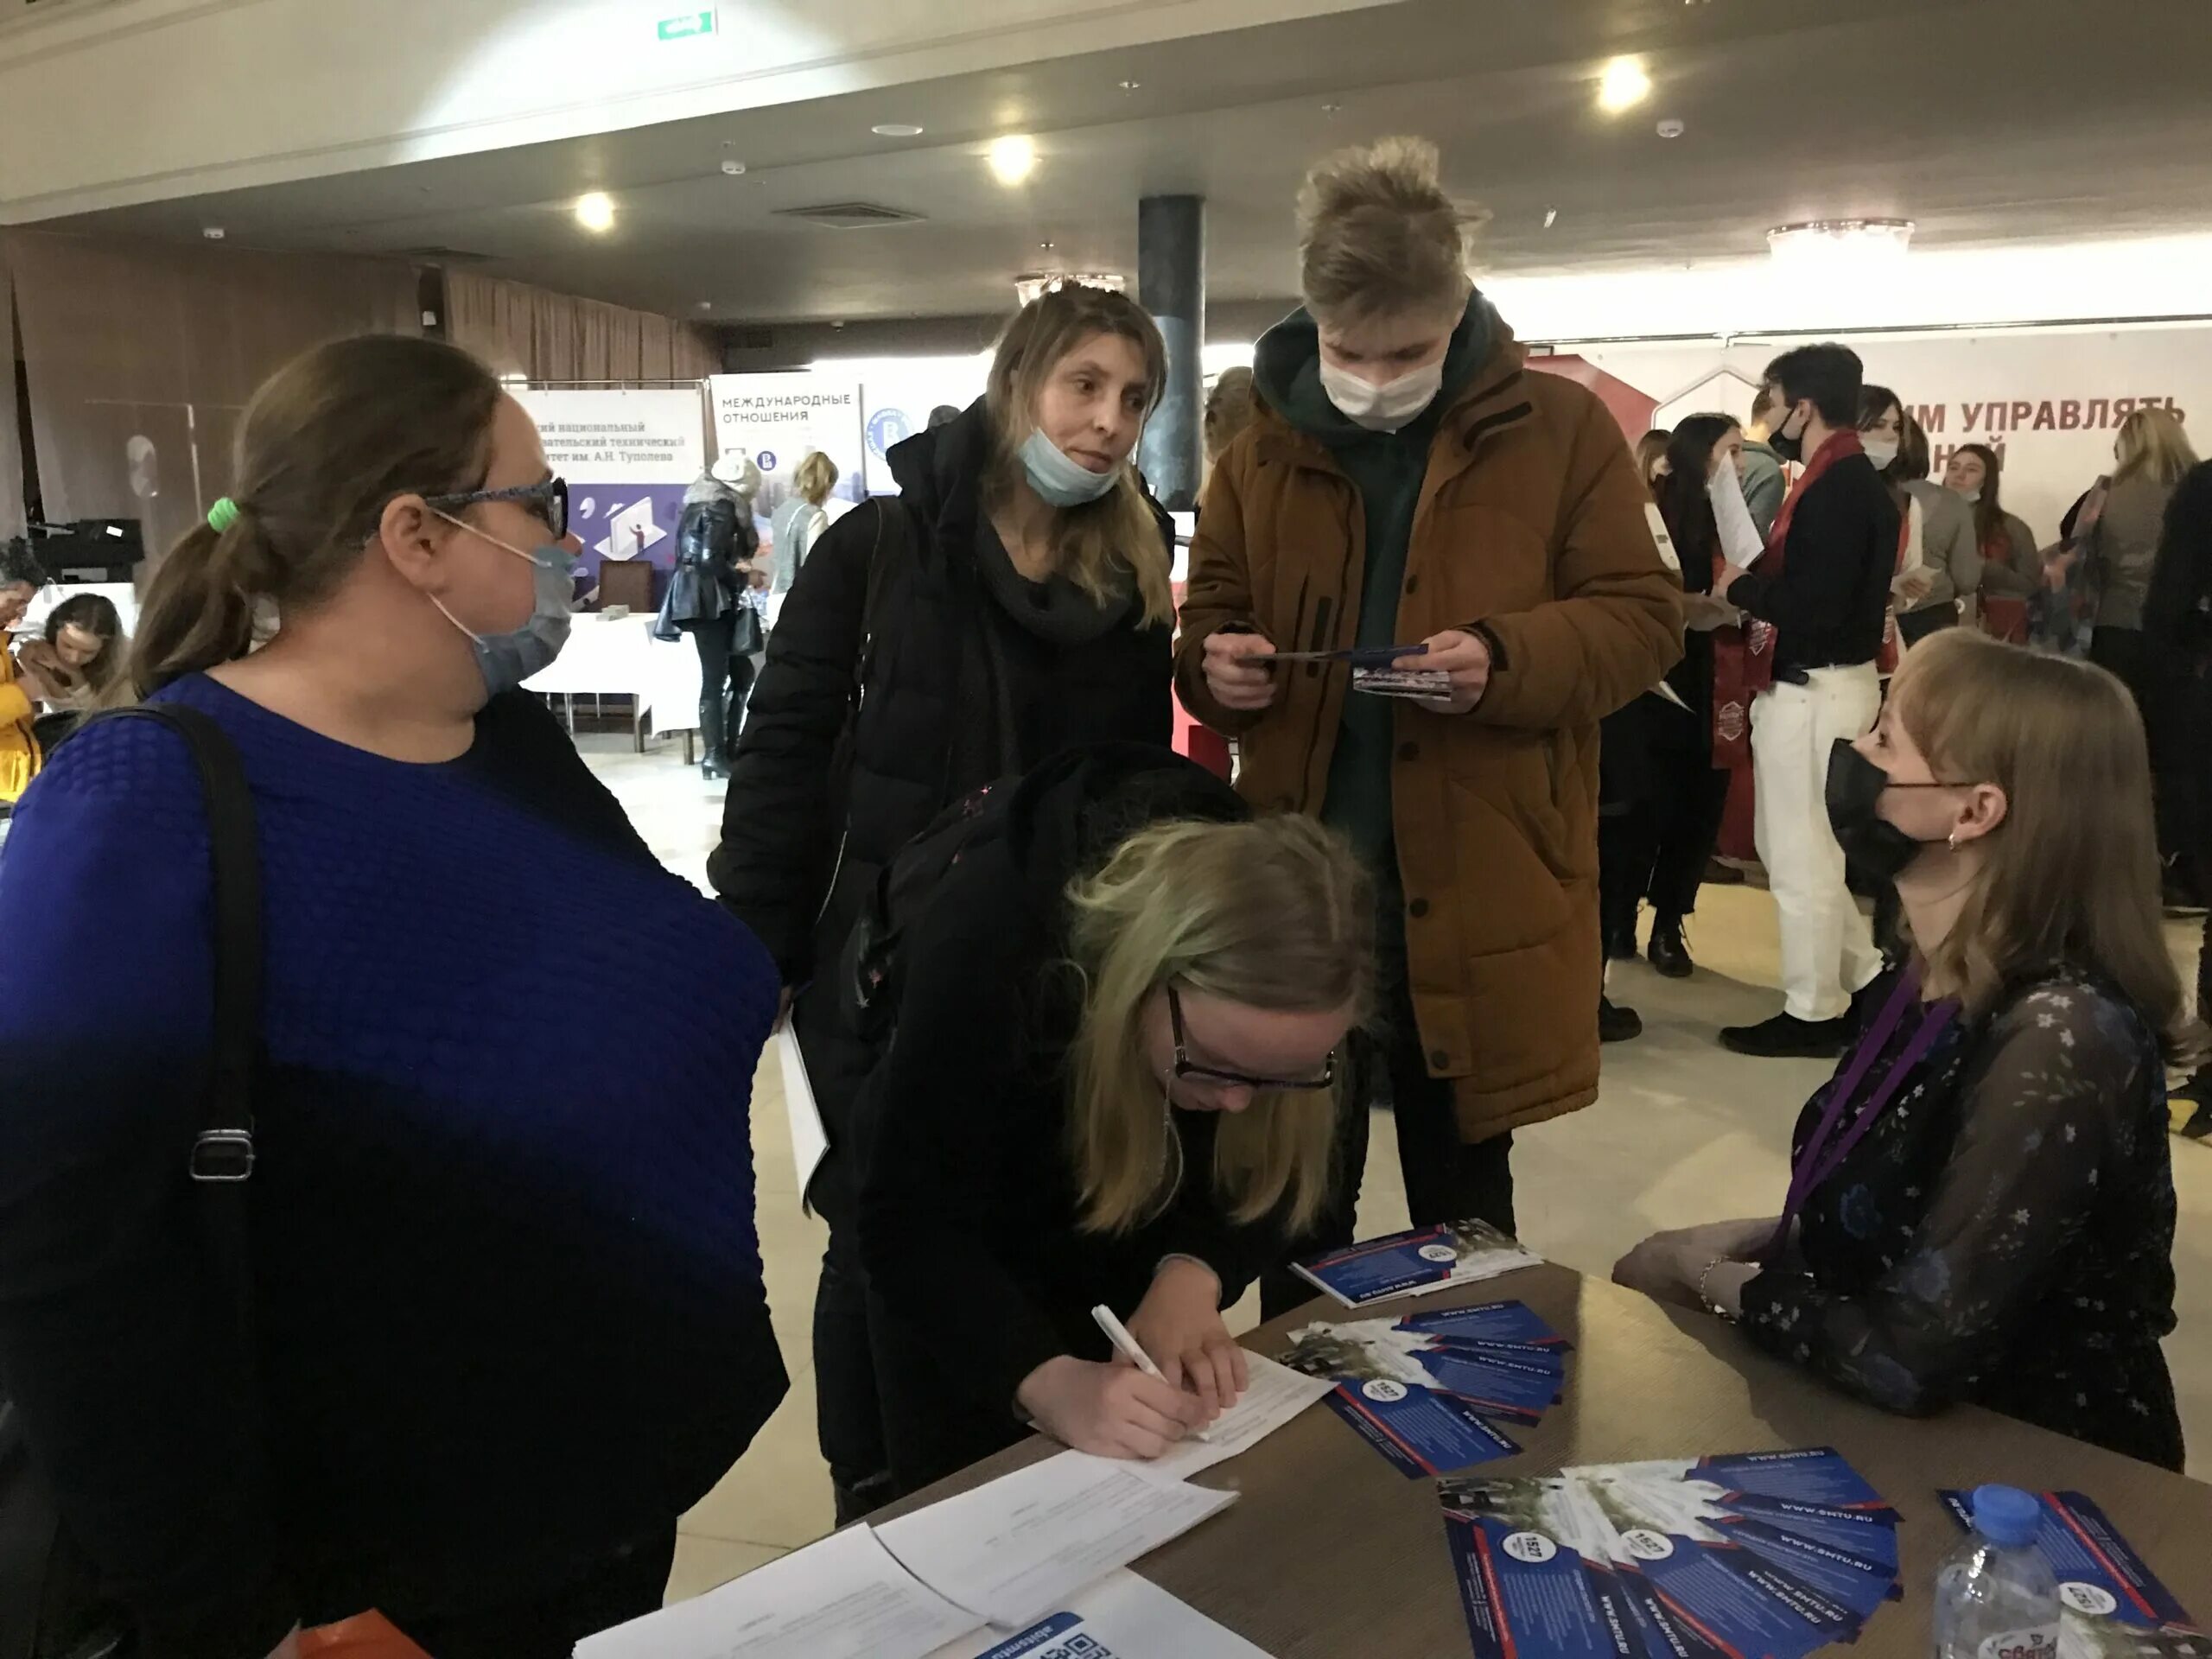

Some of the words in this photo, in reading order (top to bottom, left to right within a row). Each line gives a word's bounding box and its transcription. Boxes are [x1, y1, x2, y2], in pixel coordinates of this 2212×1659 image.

[722, 394, 851, 408] МЕЖДУНАРОДНЫЕ
[723, 410, 809, 423] ОТНОШЕНИЯ
[558, 422, 645, 433] национальный
[609, 436, 684, 448] технический
[619, 451, 673, 463] Туполева
[1525, 1536, 1542, 1558] 1527
[1635, 1533, 1665, 1553] 1527
